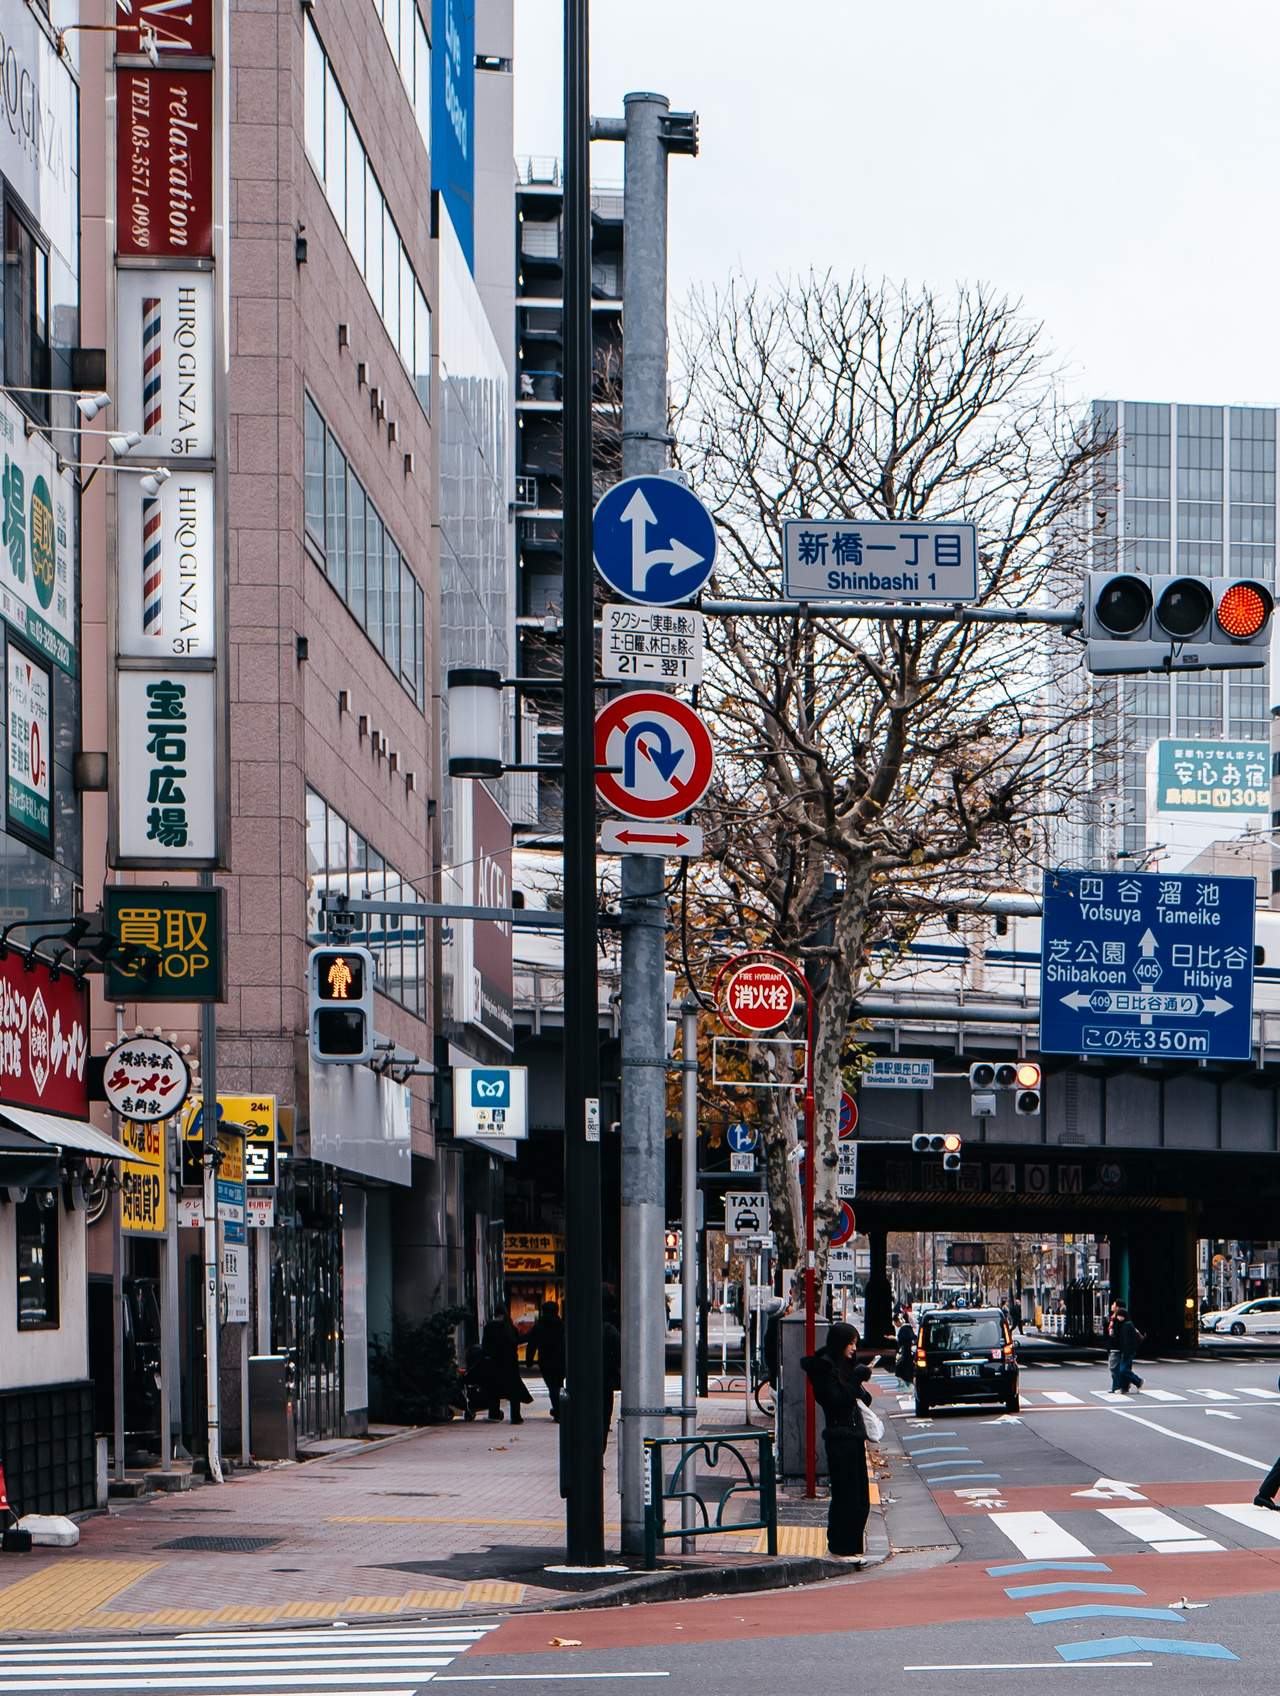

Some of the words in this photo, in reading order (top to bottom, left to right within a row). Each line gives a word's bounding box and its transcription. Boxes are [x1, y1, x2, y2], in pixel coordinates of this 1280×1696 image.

[169, 86, 198, 247] relaxation
[178, 352, 197, 433] GINZA
[170, 437, 199, 455] 3F
[797, 530, 962, 568] 新橋一丁目
[178, 554, 198, 633] GINZA
[827, 571, 919, 592] Shinbashi
[927, 572, 937, 592] 1
[172, 638, 200, 655] 3F
[145, 679, 189, 849] 宝石広場
[1174, 761, 1266, 788] 安心お宿
[1079, 877, 1142, 903] 四谷
[1158, 880, 1220, 907] 溜池
[1079, 902, 1142, 926] Yotsuya
[1156, 906, 1221, 926] Tameike
[118, 907, 208, 952] 買取
[1048, 938, 1126, 965] 芝公園
[1172, 943, 1248, 970] 日比谷
[739, 972, 753, 982] FIRE
[754, 972, 783, 982] HYDRANT
[1046, 964, 1127, 984] Shibakoen
[1183, 970, 1233, 991] Hibiya
[1136, 963, 1159, 978] 405
[734, 984, 788, 1011] 消火栓
[1091, 995, 1111, 1008] 409
[1116, 994, 1194, 1012] 日比谷通り
[51, 1008, 88, 1083] ラーメン
[1085, 1028, 1207, 1051] この先350m
[0, 1029, 22, 1078] 門店
[107, 1067, 182, 1097] ラーメン
[911, 1076, 929, 1085] Ginza
[250, 1102, 270, 1112] 24H
[730, 1196, 765, 1208] TAXI
